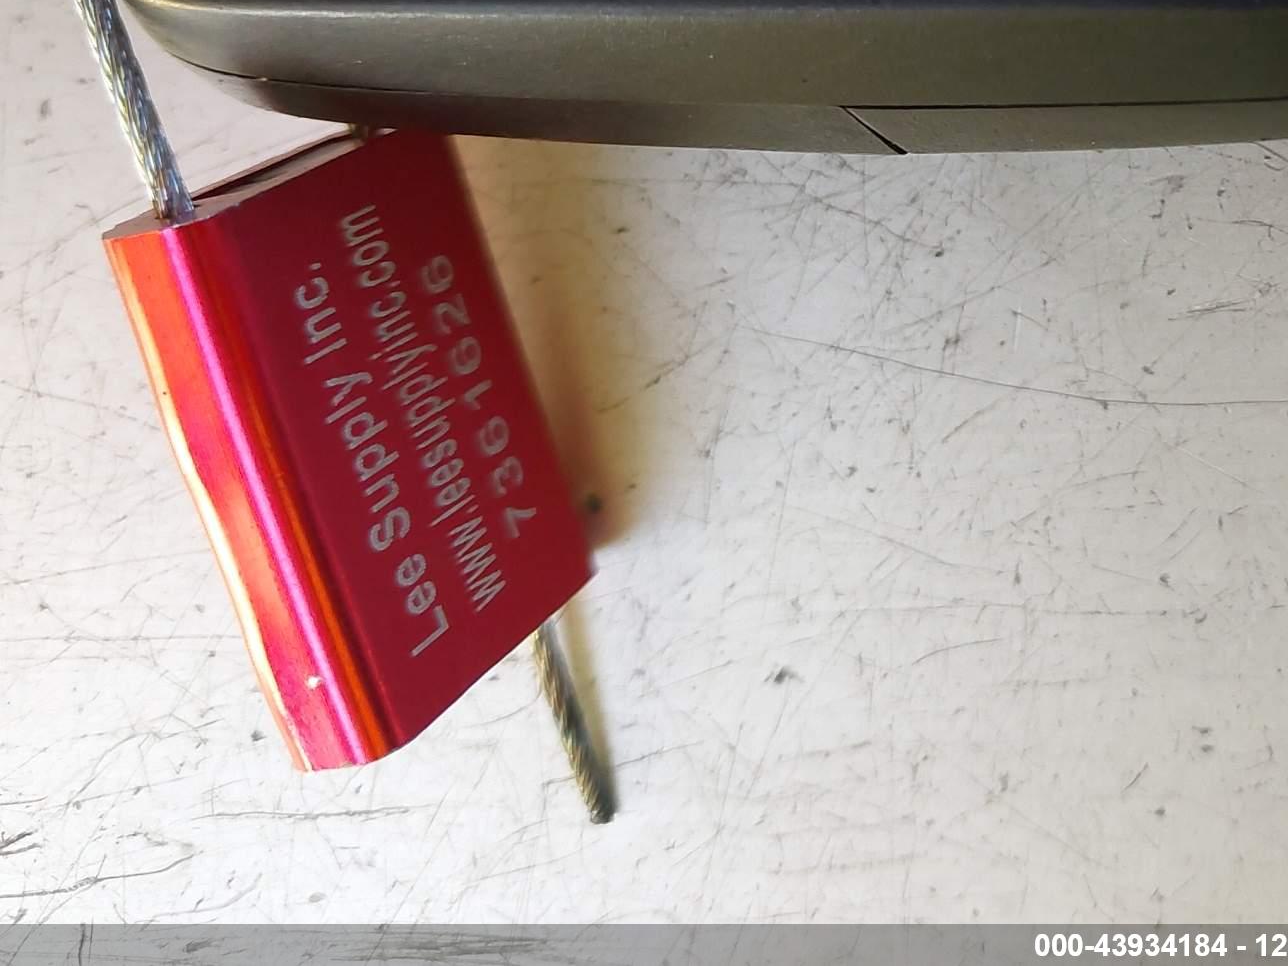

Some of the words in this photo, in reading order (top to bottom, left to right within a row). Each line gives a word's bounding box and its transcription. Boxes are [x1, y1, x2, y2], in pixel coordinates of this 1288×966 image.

[294, 262, 347, 364] Inc.
[325, 371, 413, 552] Supply
[340, 204, 507, 613] www.leesupplyinc.com
[396, 553, 450, 658] Lee
